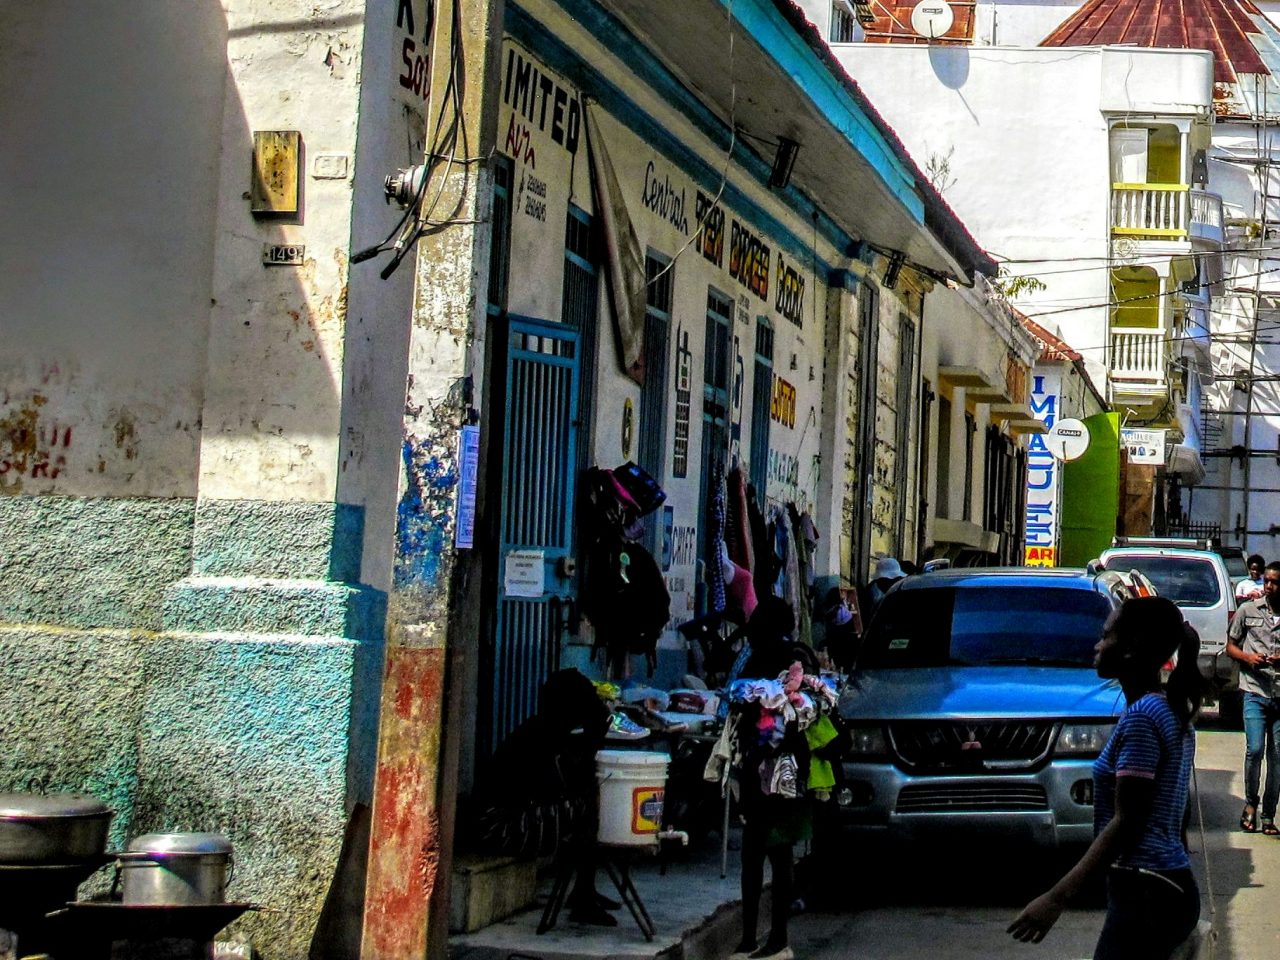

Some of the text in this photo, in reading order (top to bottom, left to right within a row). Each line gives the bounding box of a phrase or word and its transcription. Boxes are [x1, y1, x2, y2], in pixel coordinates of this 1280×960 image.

[505, 49, 580, 154] IMITED
[271, 246, 297, 261] 149
[1027, 547, 1053, 560] AR
